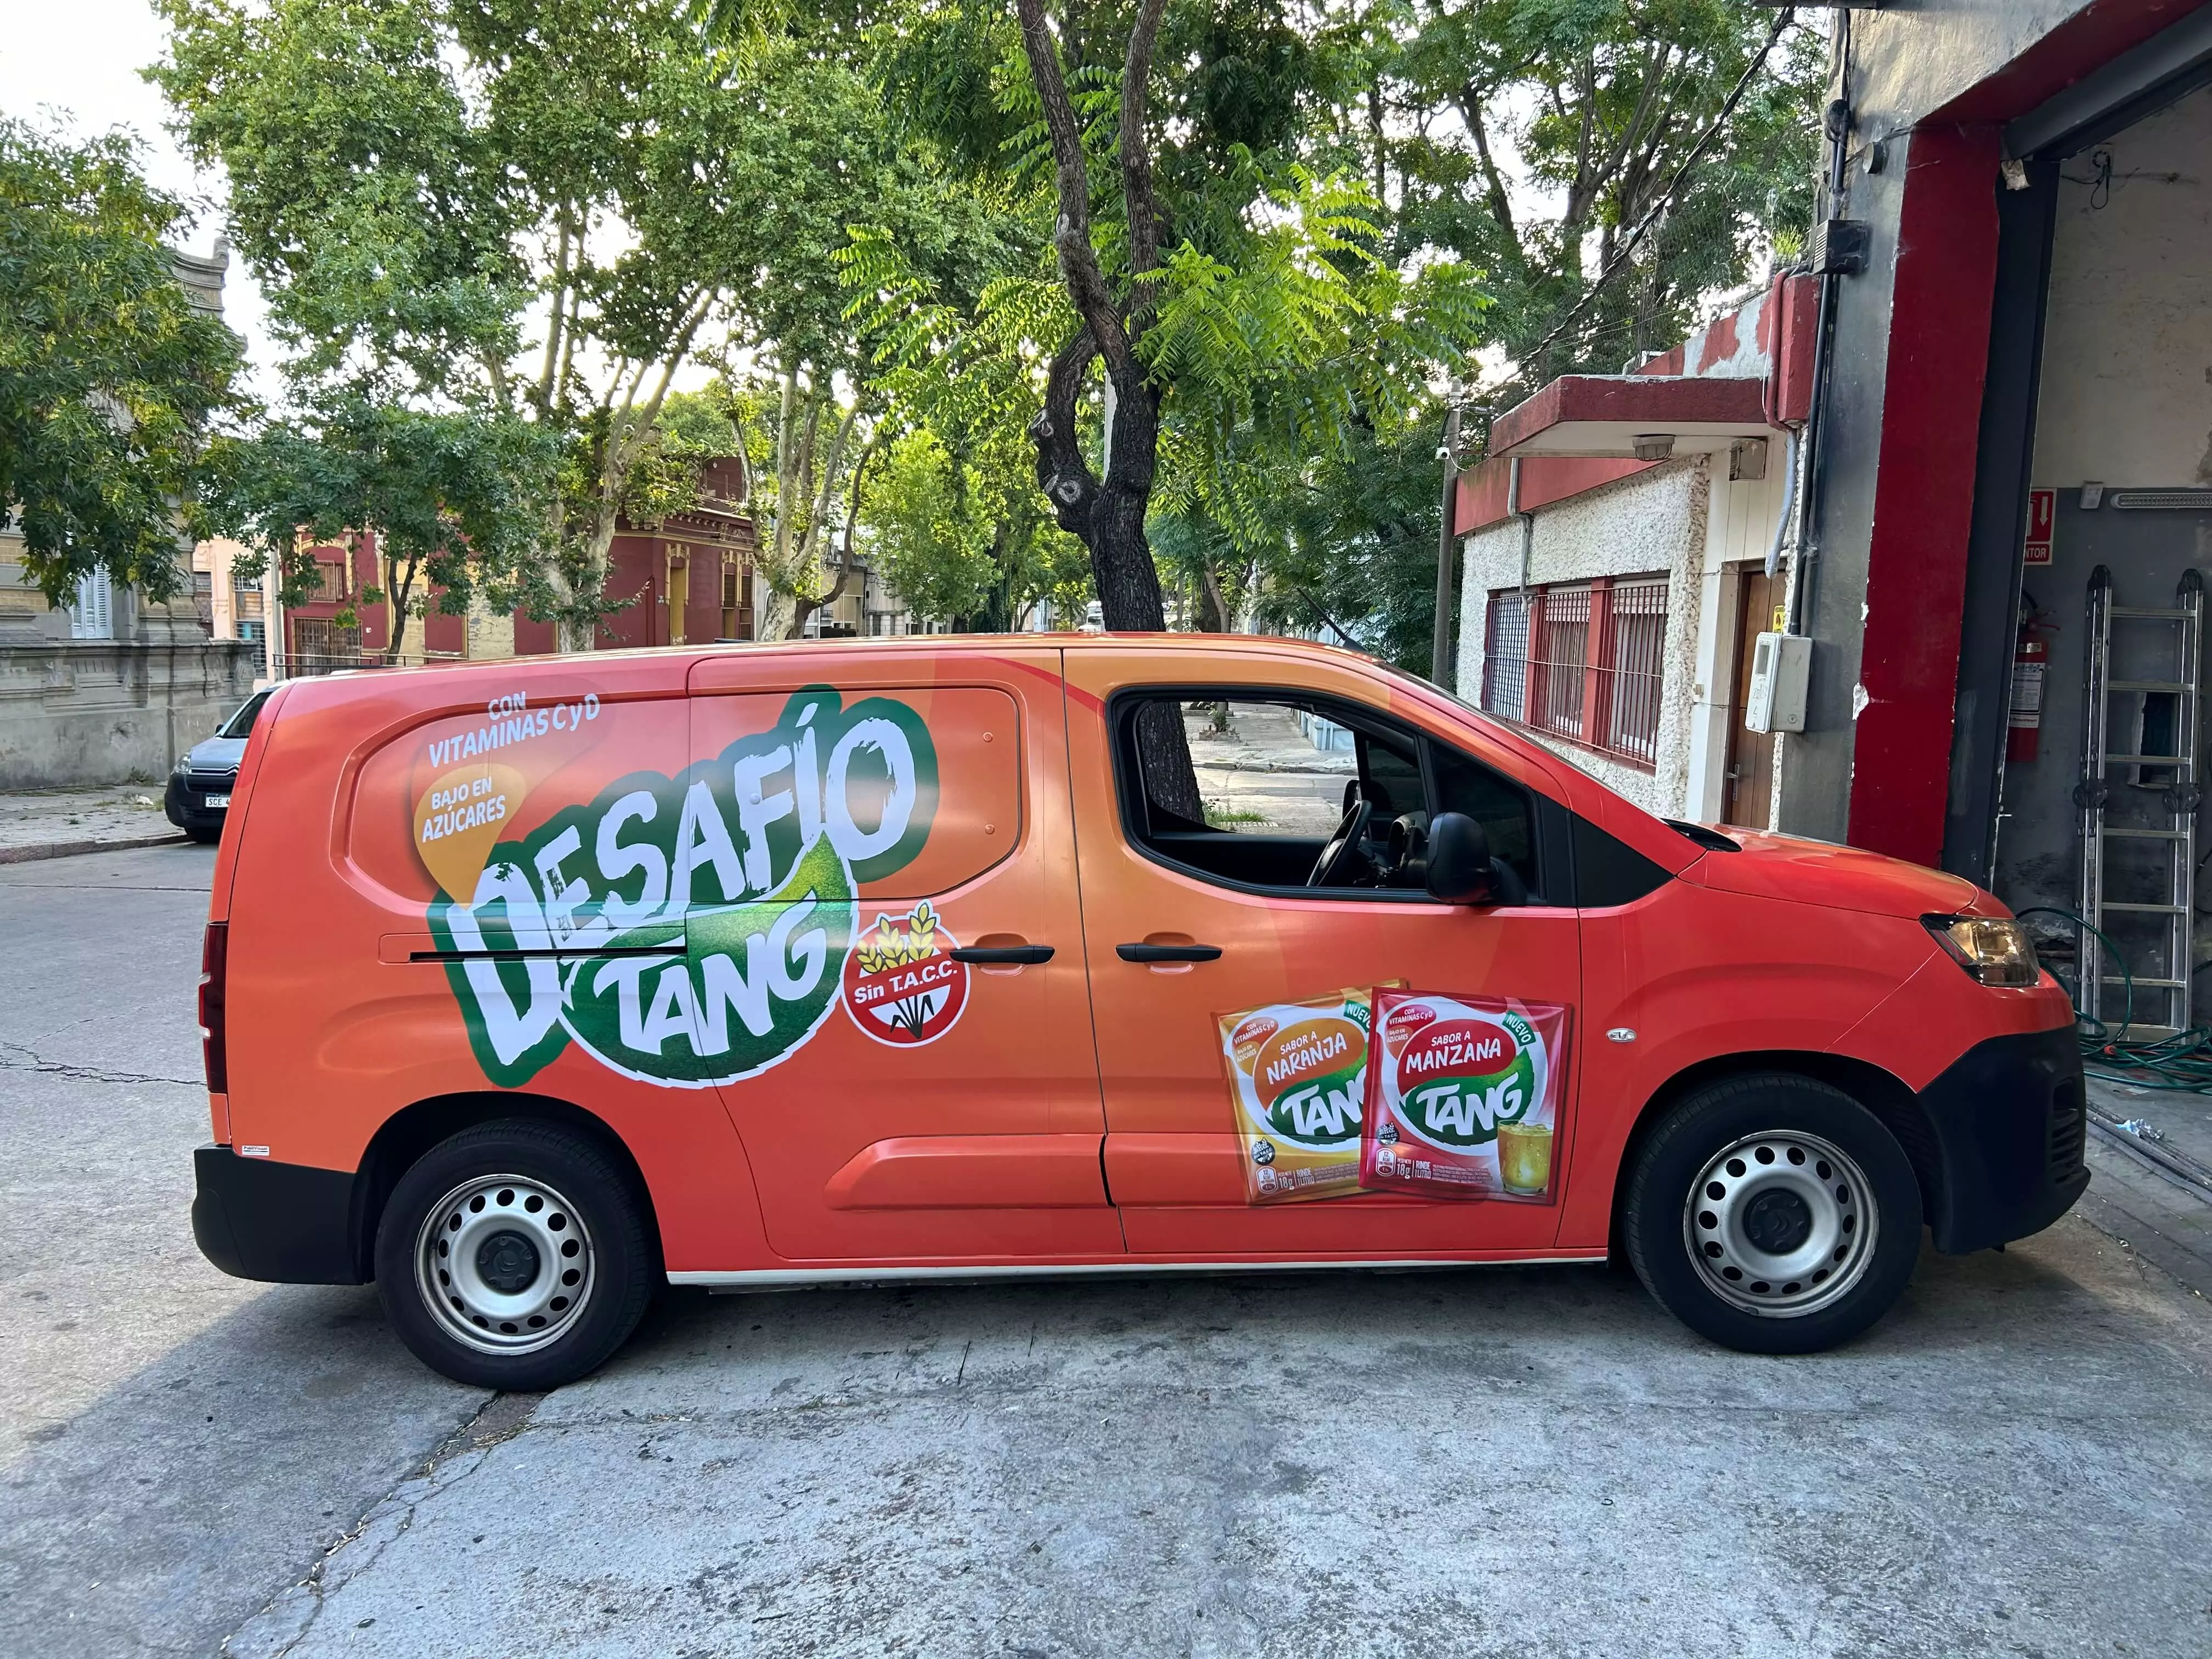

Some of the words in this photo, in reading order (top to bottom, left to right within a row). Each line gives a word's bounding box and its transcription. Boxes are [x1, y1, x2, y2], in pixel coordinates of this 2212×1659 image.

[488, 691, 526, 720] CON
[429, 708, 549, 768] VITAMINAS
[552, 703, 567, 730] C
[569, 702, 583, 731] y
[584, 693, 601, 720] D
[431, 784, 469, 810] BAJO
[472, 776, 492, 797] EN
[422, 794, 506, 843] AZÚCARES
[446, 702, 916, 1066] DESAFÍO
[593, 887, 827, 1056] TANG
[854, 984, 885, 1004] Sin
[888, 960, 958, 992] T.A.C.C.
[1246, 1022, 1257, 1031] CON
[1389, 1013, 1420, 1025] VITAMINAS
[1506, 1014, 1532, 1043] NUEVO
[1234, 1026, 1263, 1045] VITAMINAS
[1280, 1034, 1308, 1055] SABOR
[1311, 1031, 1317, 1041] A
[1431, 1032, 1462, 1047] SABOR
[1464, 1030, 1471, 1040] A
[1266, 1032, 1347, 1085] NARANJA
[1406, 1037, 1501, 1074] MANZANA
[1415, 1071, 1522, 1136] TANG
[1296, 1167, 1312, 1177] RINDE
[1397, 1163, 1411, 1179] 18g
[1416, 1160, 1431, 1170] RINDE
[1279, 1176, 1295, 1190] 18g
